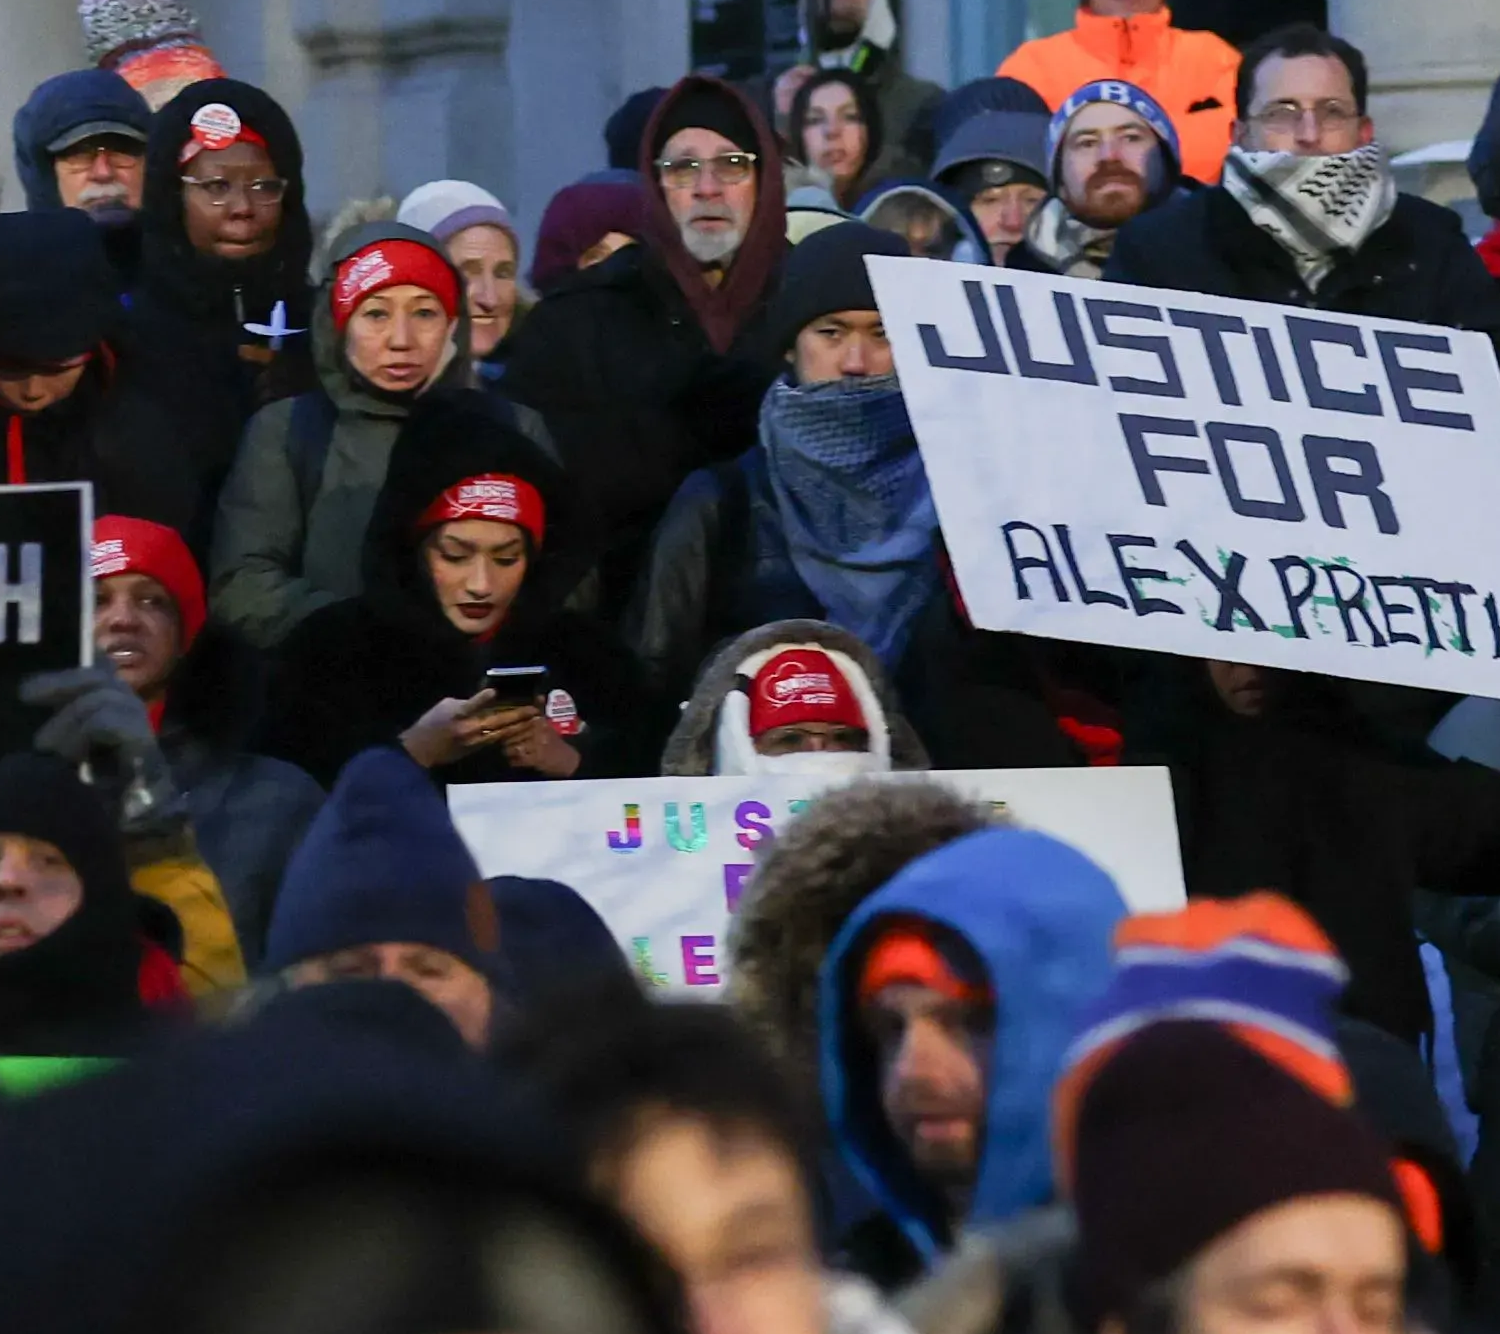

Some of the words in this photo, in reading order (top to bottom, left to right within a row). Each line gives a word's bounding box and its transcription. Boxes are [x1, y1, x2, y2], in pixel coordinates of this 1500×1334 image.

[917, 278, 1475, 432] JUSTICE
[1119, 412, 1400, 536] FOR
[1001, 520, 1269, 634] ALEX
